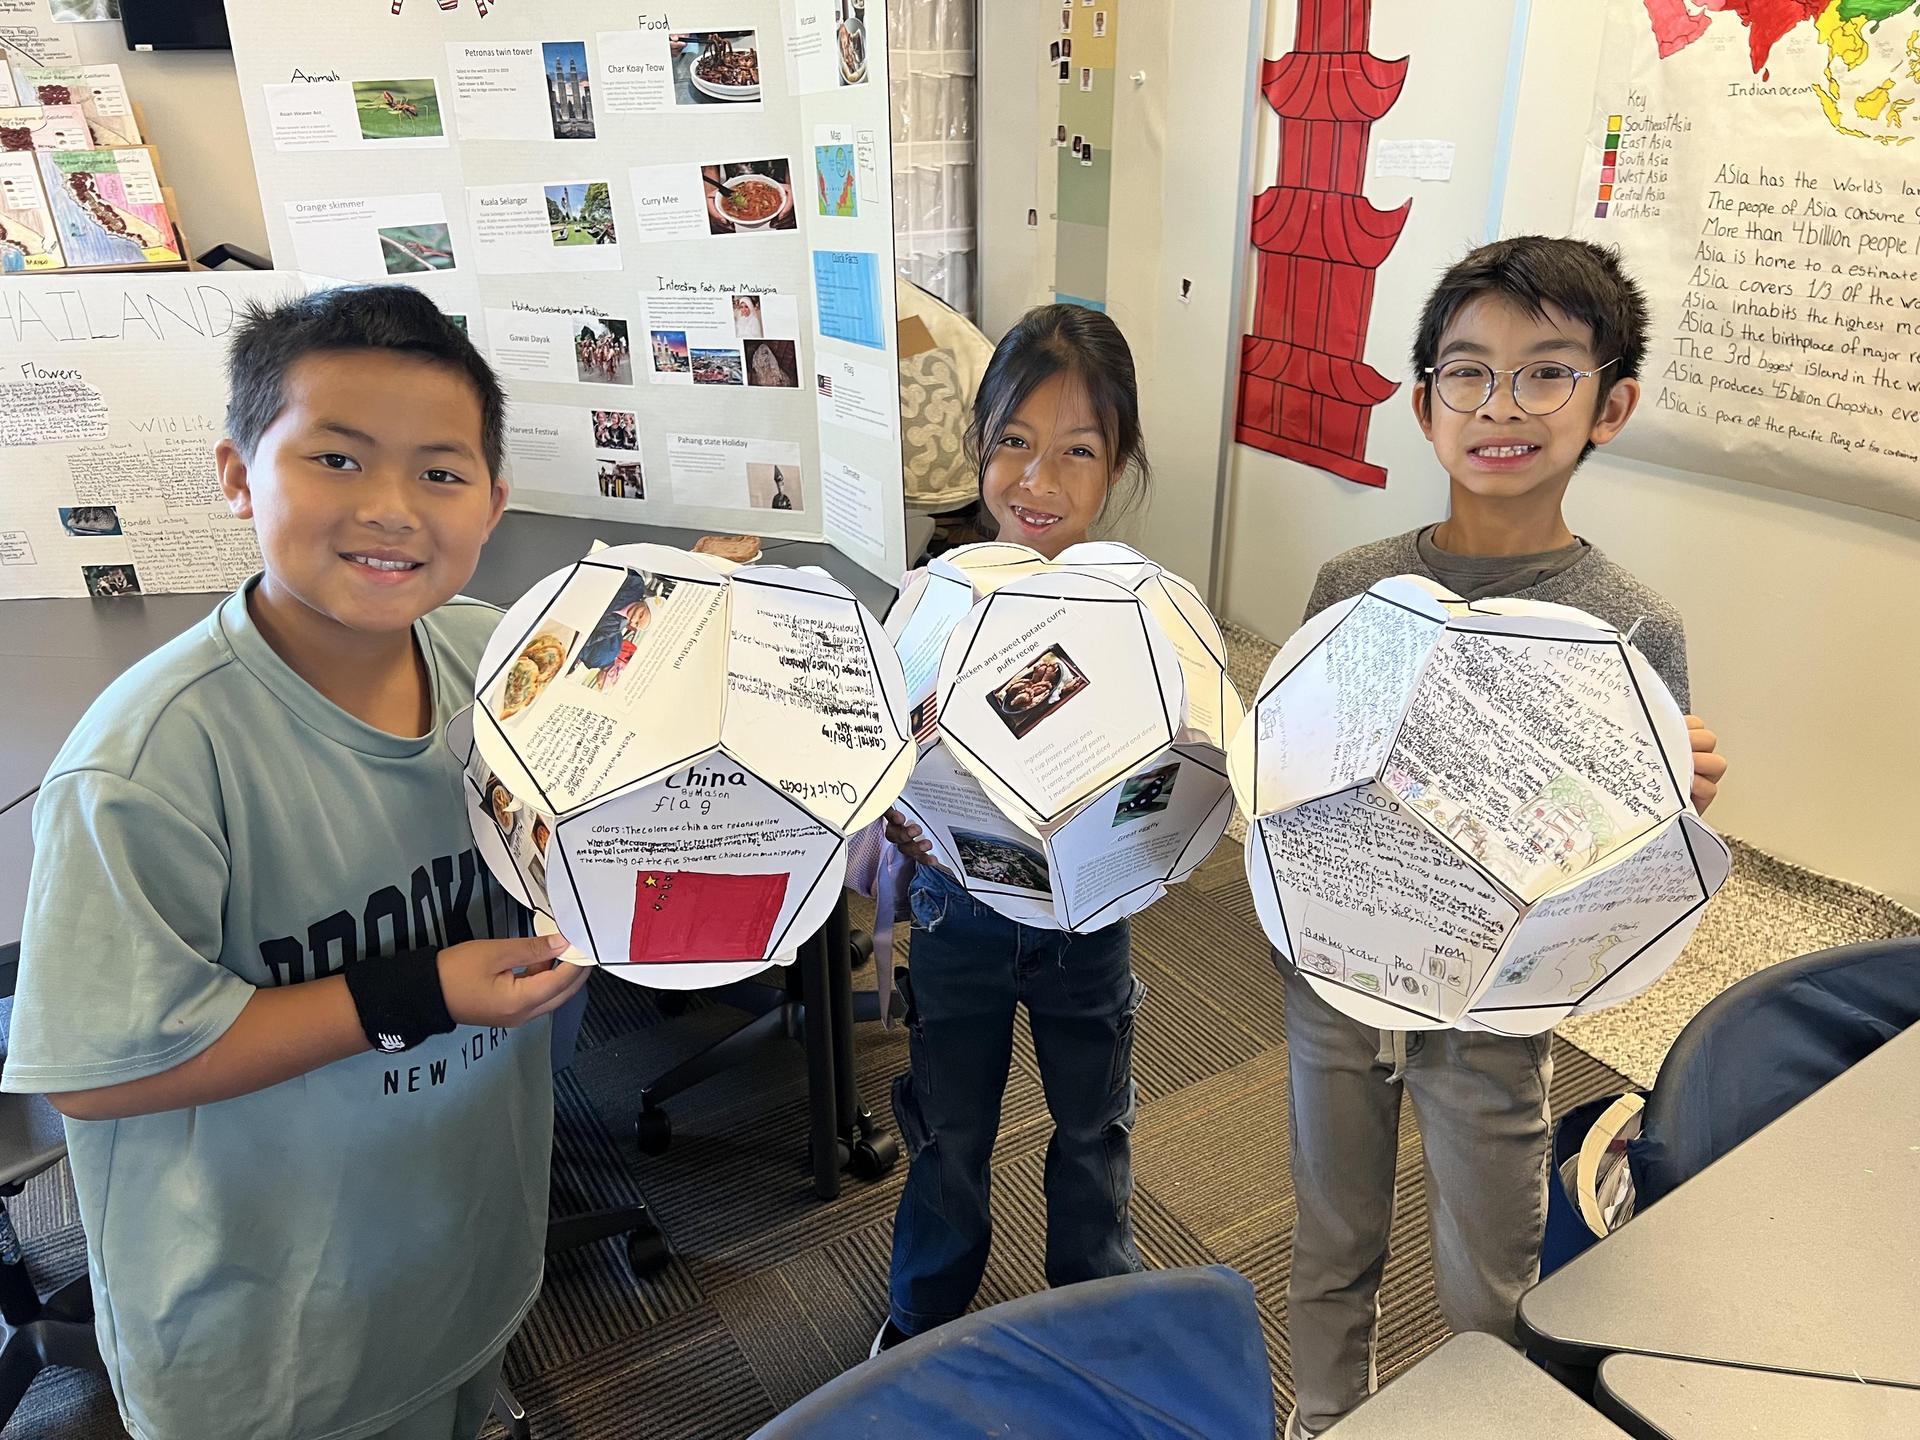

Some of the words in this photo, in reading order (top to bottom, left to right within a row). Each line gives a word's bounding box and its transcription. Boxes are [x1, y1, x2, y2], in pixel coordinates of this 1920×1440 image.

[638, 14, 670, 30] Food
[465, 48, 495, 57] Petronas
[496, 48, 512, 57] twin
[513, 48, 533, 56] tower
[291, 68, 340, 83] Animals
[608, 64, 625, 73] Char
[626, 64, 644, 74] Koay
[645, 63, 665, 72] Teow
[1728, 82, 1776, 97] Indian
[1780, 84, 1813, 97] ocean
[1628, 88, 1647, 112] Key
[1621, 134, 1647, 149] East
[1650, 133, 1672, 149] Asia
[1618, 151, 1645, 166] South
[1647, 152, 1669, 167] Asia
[1617, 169, 1646, 183] West
[1646, 170, 1668, 184] Asia
[1760, 166, 1784, 188] has
[1795, 170, 1818, 189] the
[480, 198, 499, 206] Kuala
[500, 196, 528, 207] Selangor
[641, 197, 661, 206] Curry
[662, 196, 679, 204] Mee
[1645, 186, 1665, 201] Asia
[295, 203, 327, 213] Orange
[328, 200, 366, 210] skimmer
[1612, 203, 1639, 219] North
[1640, 203, 1660, 218] Asia
[1708, 190, 1734, 212] The
[1737, 200, 1775, 218] people
[1781, 199, 1798, 215] of
[1845, 206, 1905, 224] consume
[1701, 217, 1739, 239] More
[1745, 220, 1783, 243] than
[1857, 234, 1908, 258] people
[1734, 250, 1746, 265] is
[1755, 249, 1796, 270] home
[1804, 258, 1821, 272] to
[1831, 264, 1842, 274] a
[1739, 279, 1793, 296] covers
[1807, 278, 1832, 300] 1/3
[1869, 285, 1894, 307] the
[1732, 297, 1797, 321] inhabits
[1807, 307, 1828, 325] the
[1834, 311, 1884, 332] highest
[1720, 319, 1734, 338] is
[1741, 323, 1766, 343] the
[1772, 325, 1835, 354] birthplace
[1841, 336, 1860, 355] of
[1862, 345, 1901, 363] major
[21, 361, 82, 380] Flowers
[1673, 336, 1714, 361] The
[1725, 342, 1750, 366] 3rd
[1758, 349, 1795, 373] biggest
[1852, 369, 1865, 385] in
[1872, 367, 1902, 390] the
[1709, 374, 1764, 397] produces
[183, 414, 215, 432] Life
[509, 426, 534, 436] Harvest
[535, 427, 559, 437] Festival
[1696, 400, 1708, 417] is
[1715, 409, 1743, 425] part
[1746, 415, 1761, 428] of
[1766, 416, 1785, 434] the
[1830, 431, 1851, 450] Ring
[1854, 438, 1866, 449] of
[677, 436, 703, 447] Pahang
[704, 438, 721, 446] state
[722, 438, 749, 448] Holiday
[705, 582, 730, 617] Double
[694, 617, 709, 637] nine
[673, 638, 698, 670] festival
[955, 662, 984, 685] chicken
[984, 652, 998, 667] and
[998, 638, 1021, 656] sweet
[1021, 620, 1046, 641] potato
[1046, 607, 1067, 623] curry
[996, 656, 1016, 673] puffs
[1016, 640, 1040, 659] recipe
[664, 765, 747, 789] China
[694, 788, 730, 799] Mason
[1356, 787, 1400, 812] Food
[651, 796, 711, 815] flag
[631, 857, 644, 865] of
[645, 856, 662, 865] the
[384, 1058, 447, 1096] NEW
